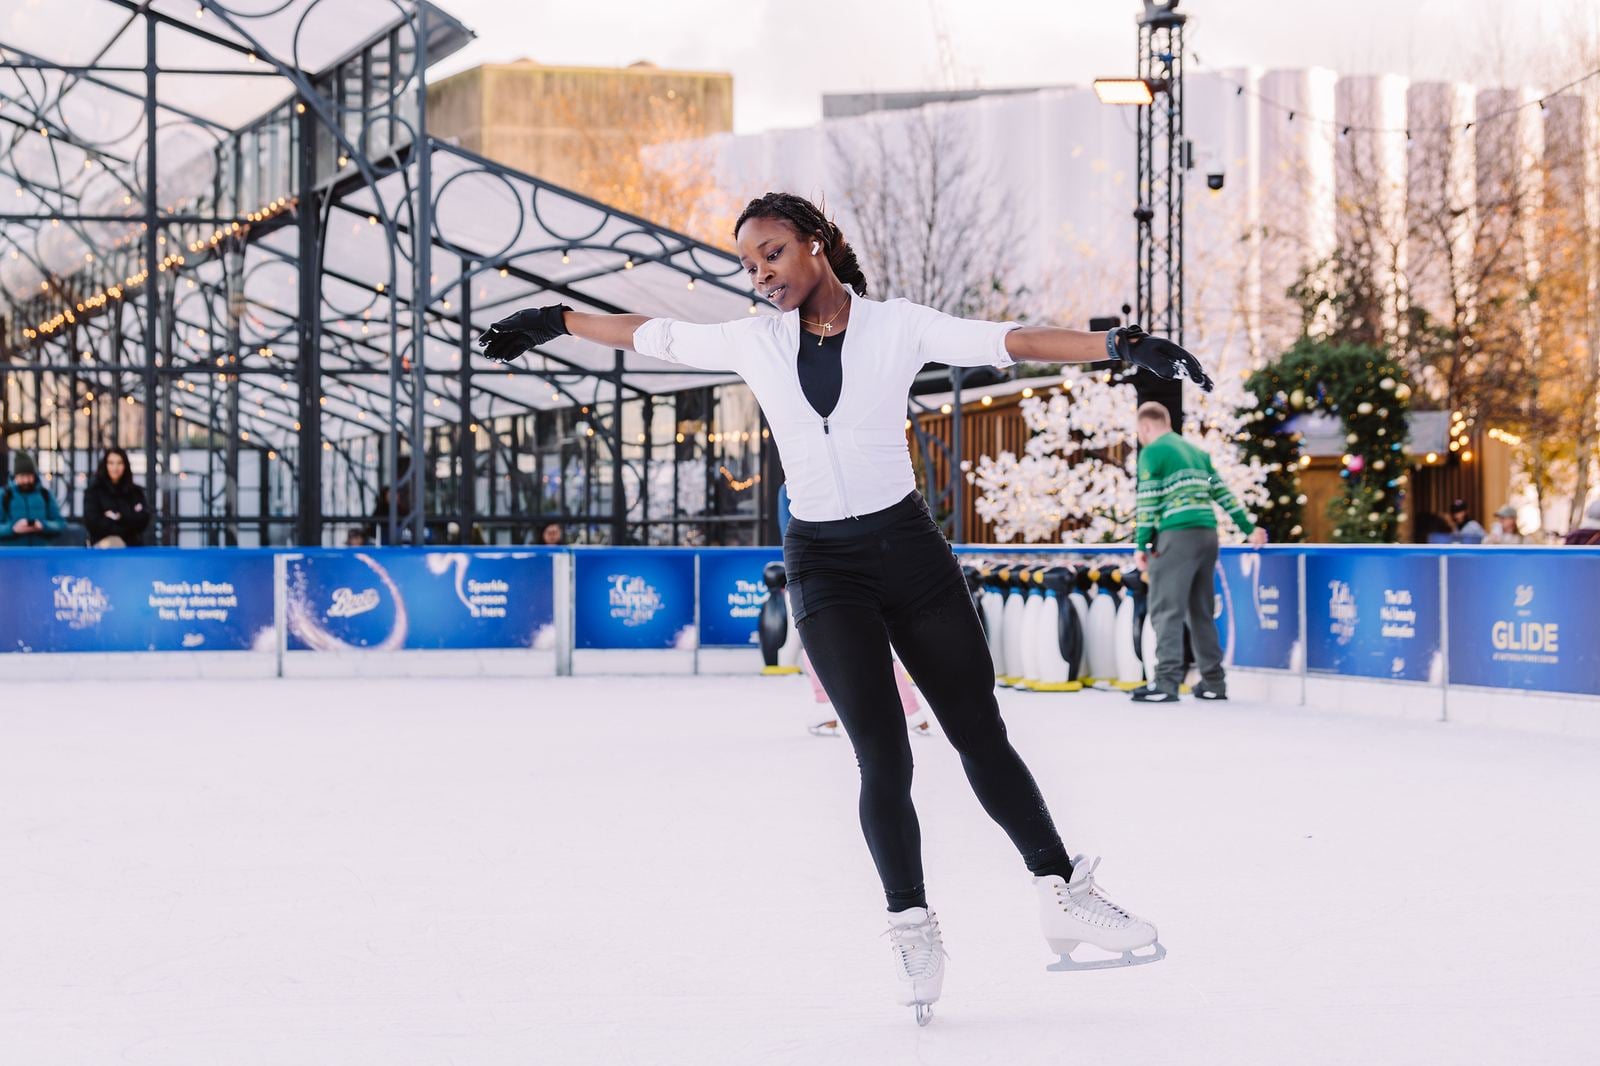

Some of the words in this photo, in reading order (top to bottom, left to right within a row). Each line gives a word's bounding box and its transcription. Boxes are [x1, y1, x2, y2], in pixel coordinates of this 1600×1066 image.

[152, 581, 191, 594] There's
[192, 583, 201, 594] a
[202, 580, 235, 594] Boots
[468, 579, 509, 594] Sparkle
[736, 580, 757, 593] The
[148, 594, 188, 609] beauty
[189, 595, 217, 608] store
[218, 595, 238, 607] not
[327, 587, 380, 617] Boots
[179, 607, 196, 620] far
[196, 608, 228, 623] away
[1492, 620, 1559, 652] GLIDE
